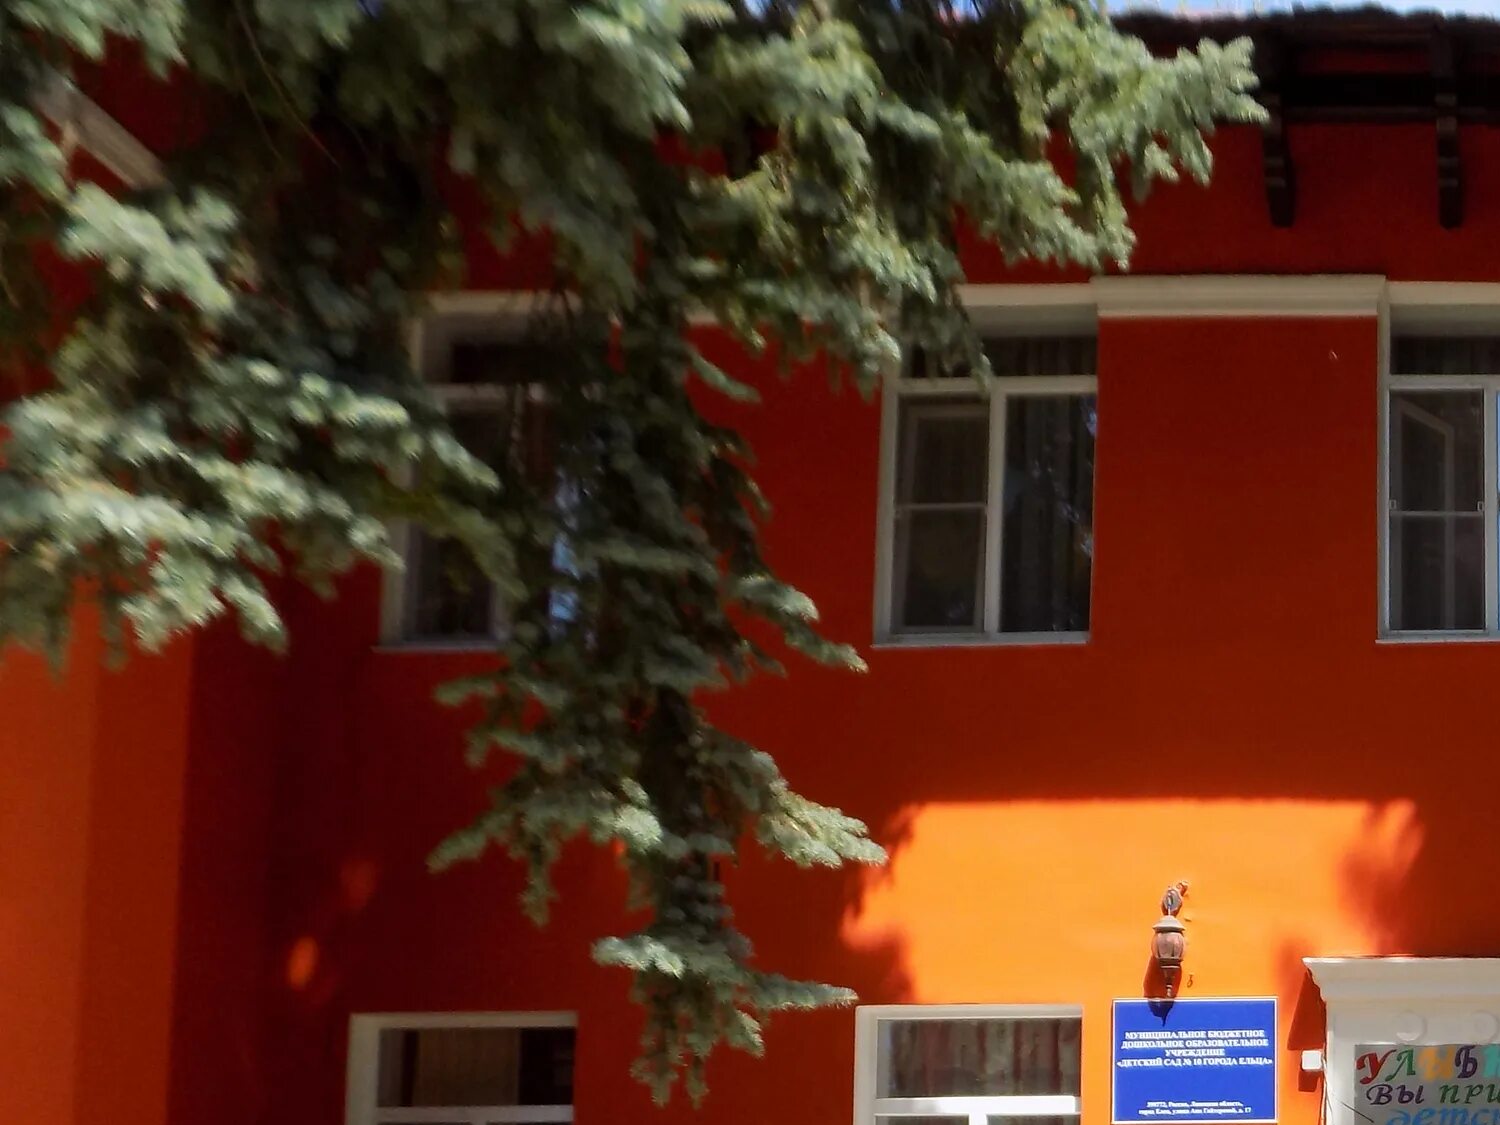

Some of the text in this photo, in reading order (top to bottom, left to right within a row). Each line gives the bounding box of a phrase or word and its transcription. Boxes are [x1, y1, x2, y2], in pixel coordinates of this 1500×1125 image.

[1125, 1030, 1265, 1040] МУНИЦИПАЛЬНОЕ БЮДЖЕТНОЕ
[1121, 1039, 1269, 1049] ДОШКОЛЬНОЕ ОБРАЗОВАТЕЛЬНОЕ
[1164, 1049, 1226, 1057] УЧРЕЖДЕНИЕ
[1164, 1058, 1182, 1067] САД
[1193, 1058, 1203, 1066] 10
[1203, 1058, 1237, 1066] ГОРОДА
[1366, 1083, 1425, 1106] Вы
